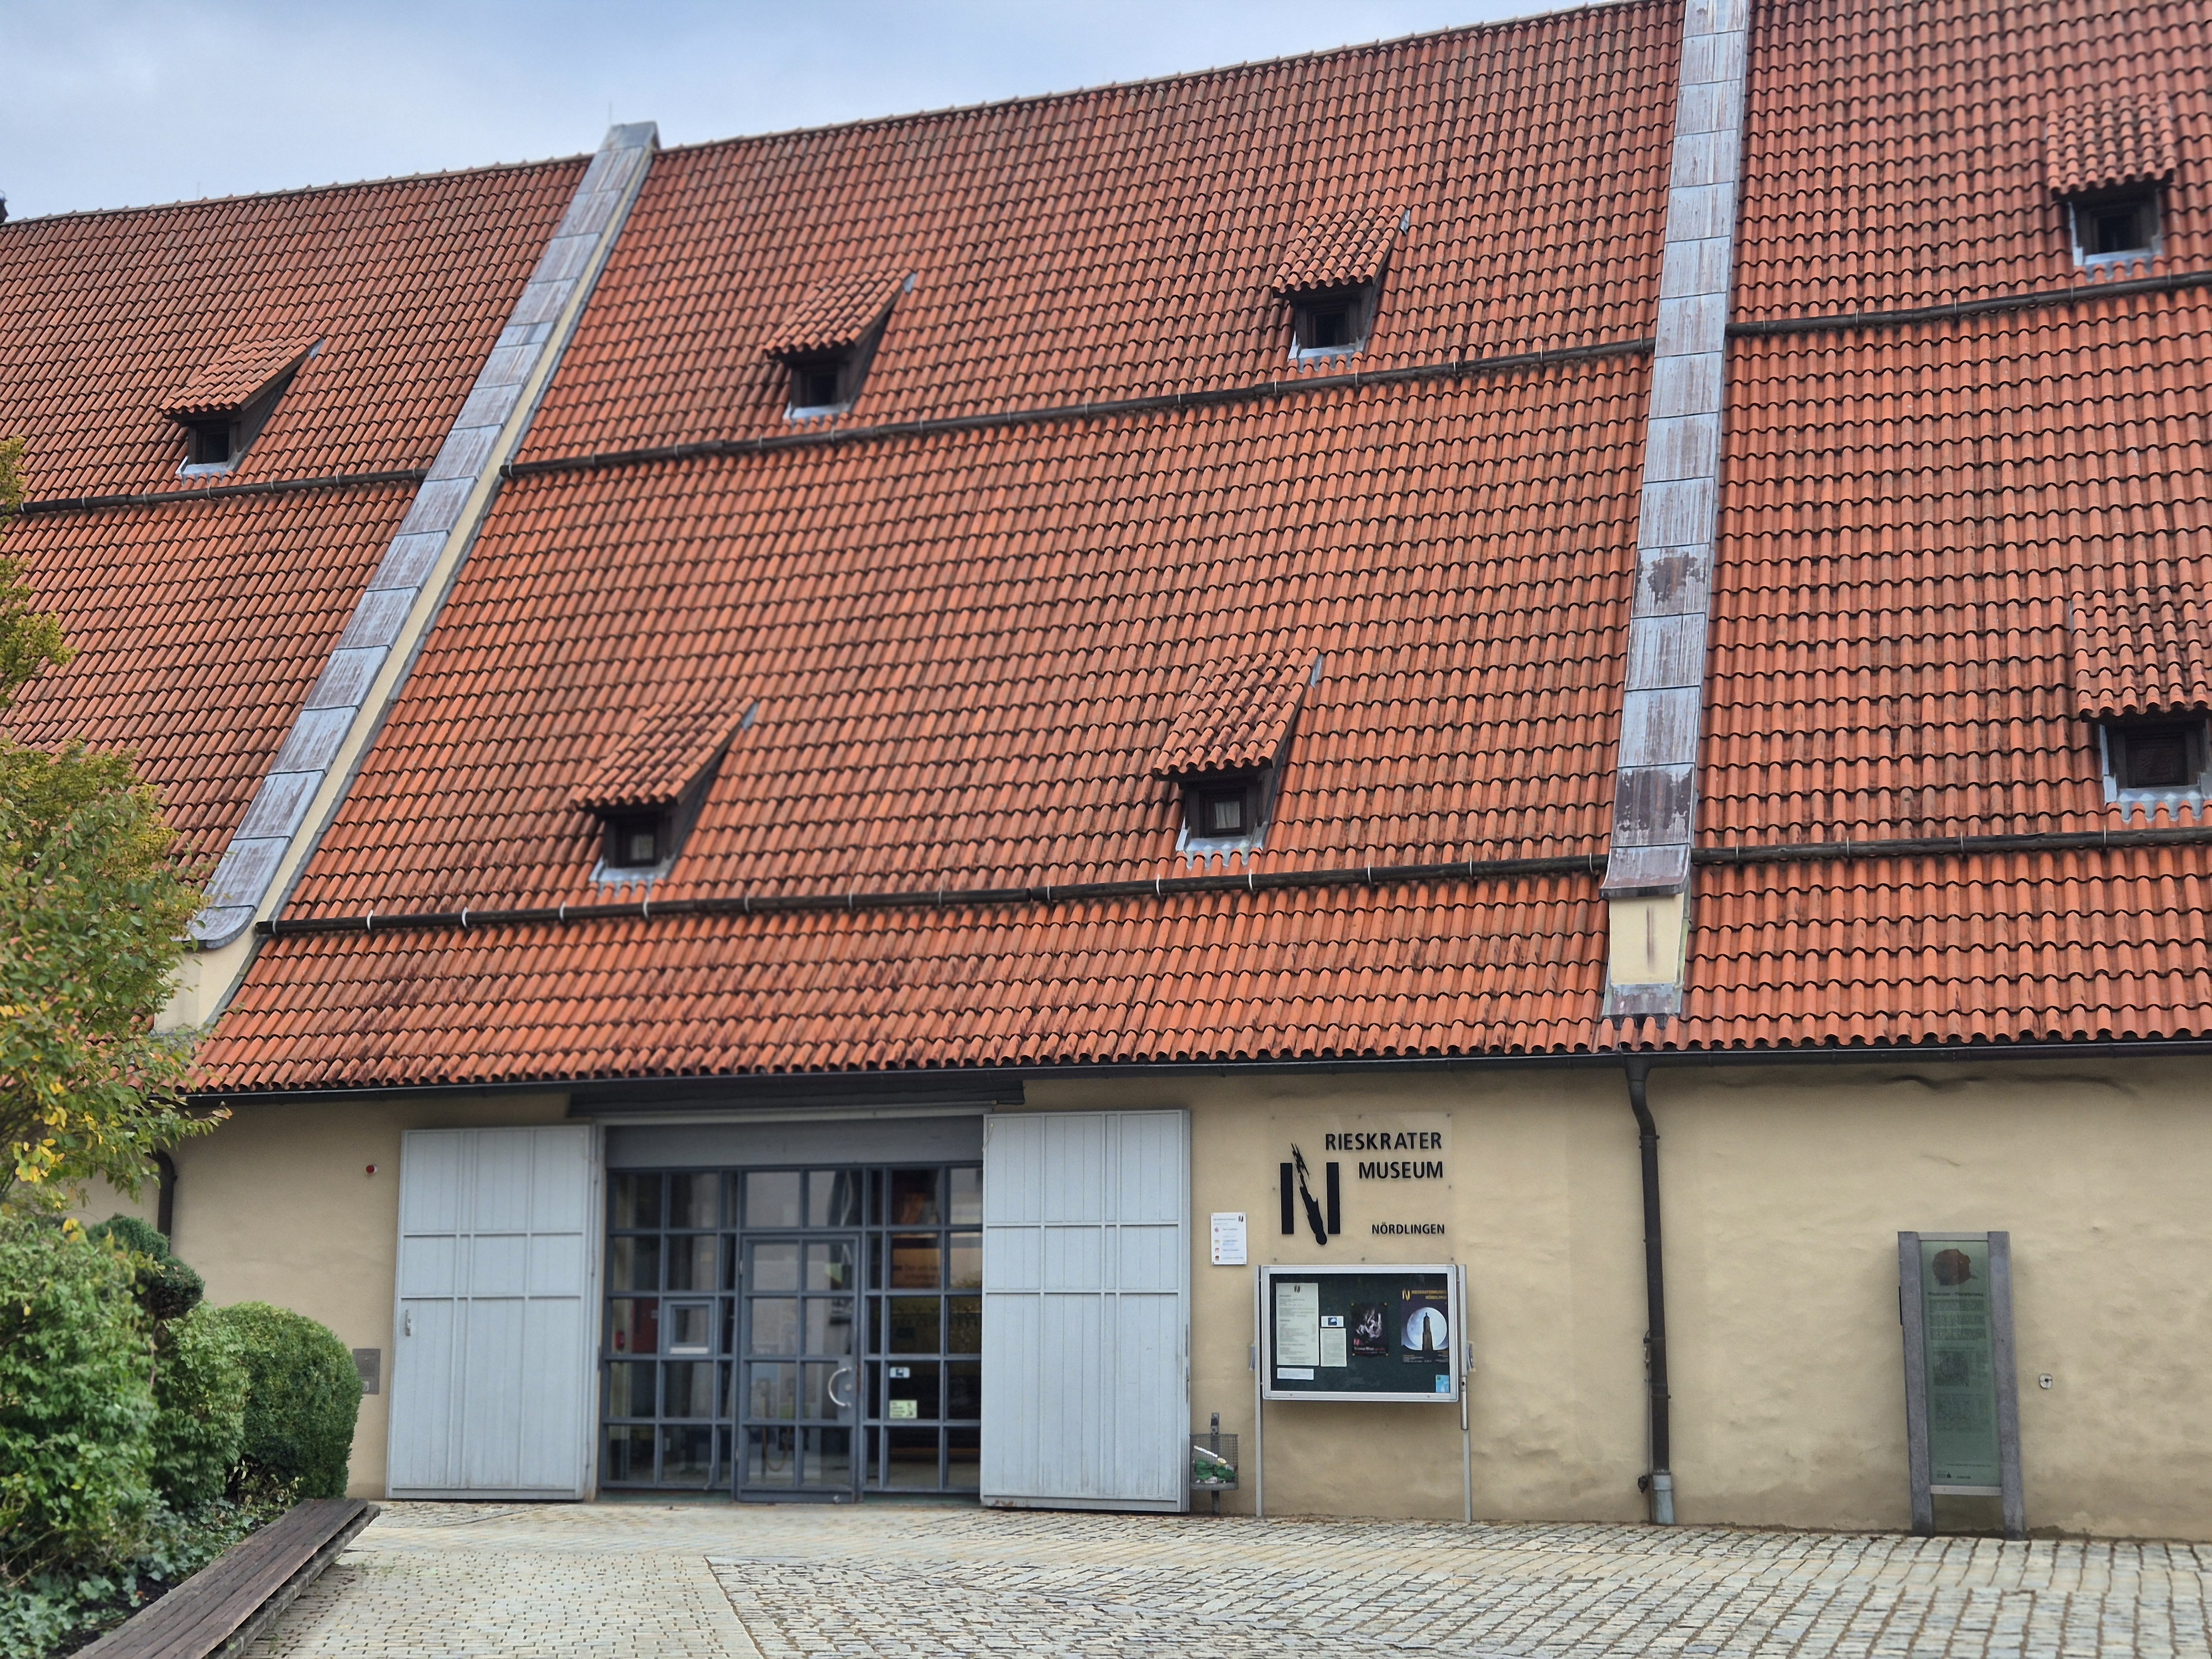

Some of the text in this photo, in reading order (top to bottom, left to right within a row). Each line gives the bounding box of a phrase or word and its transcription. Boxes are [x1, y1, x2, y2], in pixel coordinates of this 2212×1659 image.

[1325, 1132, 1442, 1151] RIESKRATER
[1359, 1161, 1443, 1179] MUSEUM
[1371, 1222, 1445, 1235] NÖRDLINGEN
